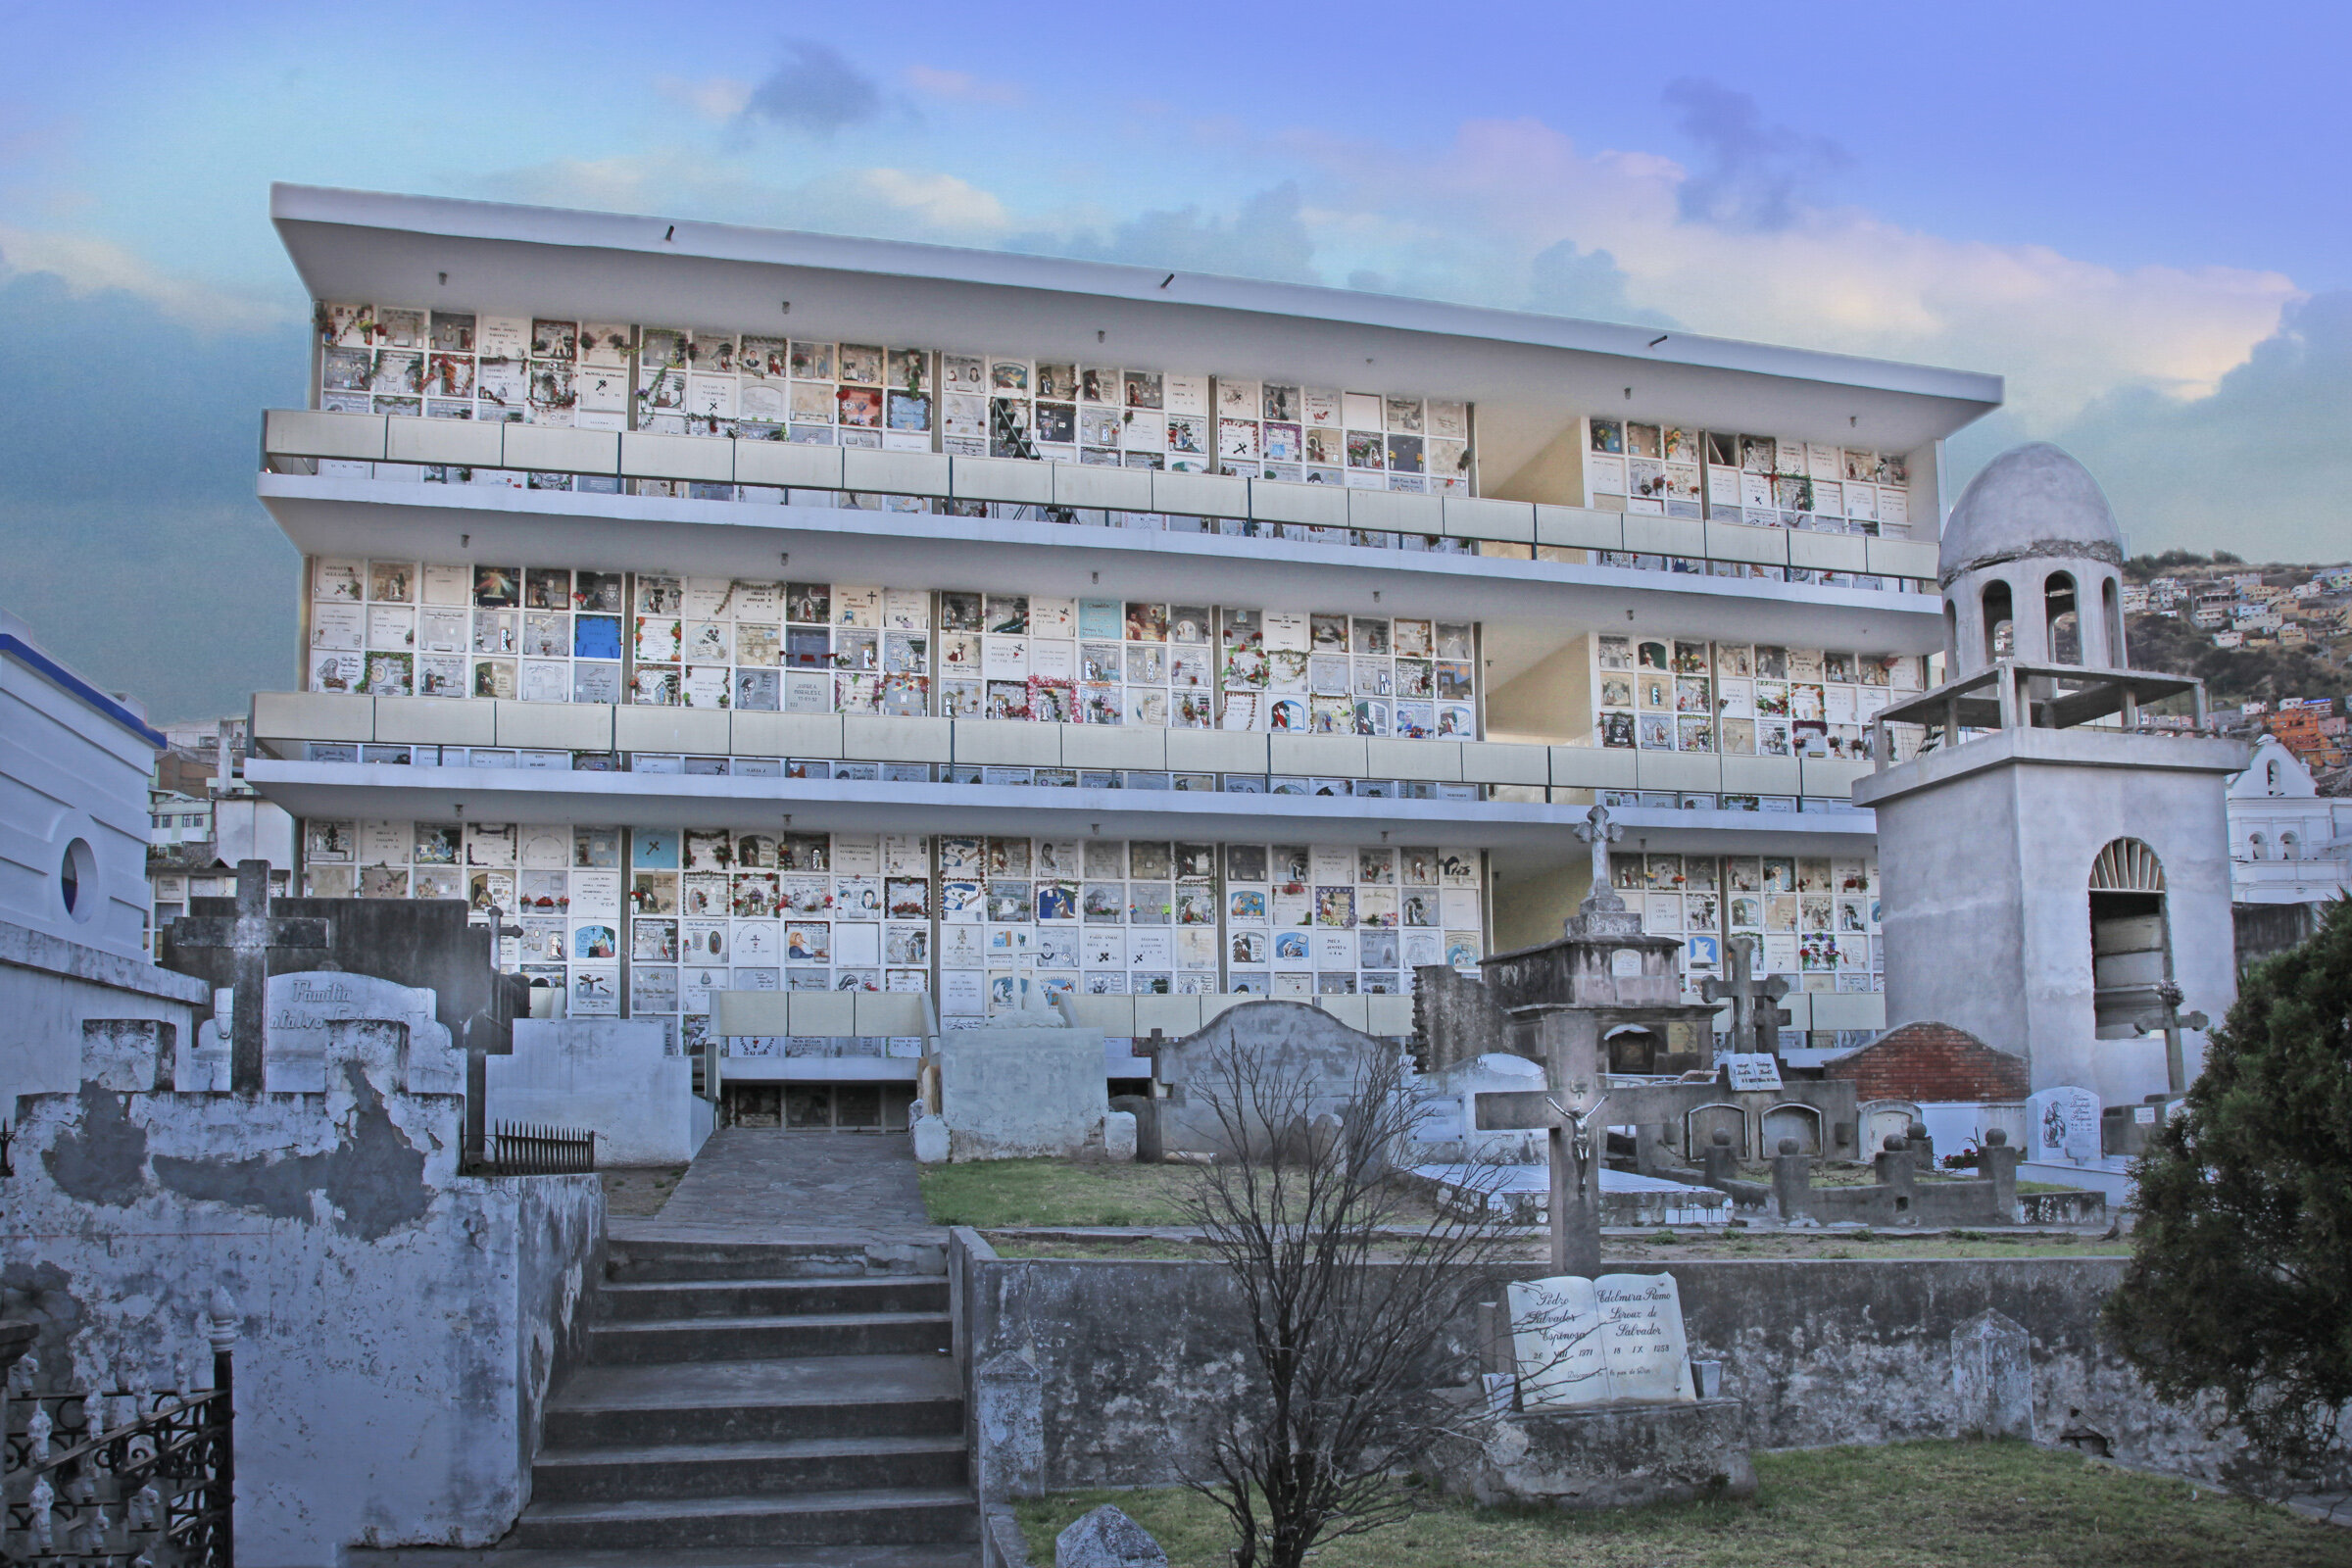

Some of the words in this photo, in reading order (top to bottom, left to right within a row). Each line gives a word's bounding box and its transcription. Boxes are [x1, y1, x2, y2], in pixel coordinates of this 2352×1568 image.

[291, 980, 353, 1004] Familia
[268, 1009, 325, 1030] ntalvo
[1536, 1291, 1569, 1306] Pedro
[1596, 1289, 1642, 1303] Edelmira
[1642, 1287, 1671, 1301] Romo
[1526, 1309, 1576, 1325] Salvador
[1646, 1305, 1658, 1318] de
[1539, 1327, 1585, 1347] Espinosa
[1615, 1321, 1662, 1337] Salvador
[1632, 1345, 1643, 1354] IX
